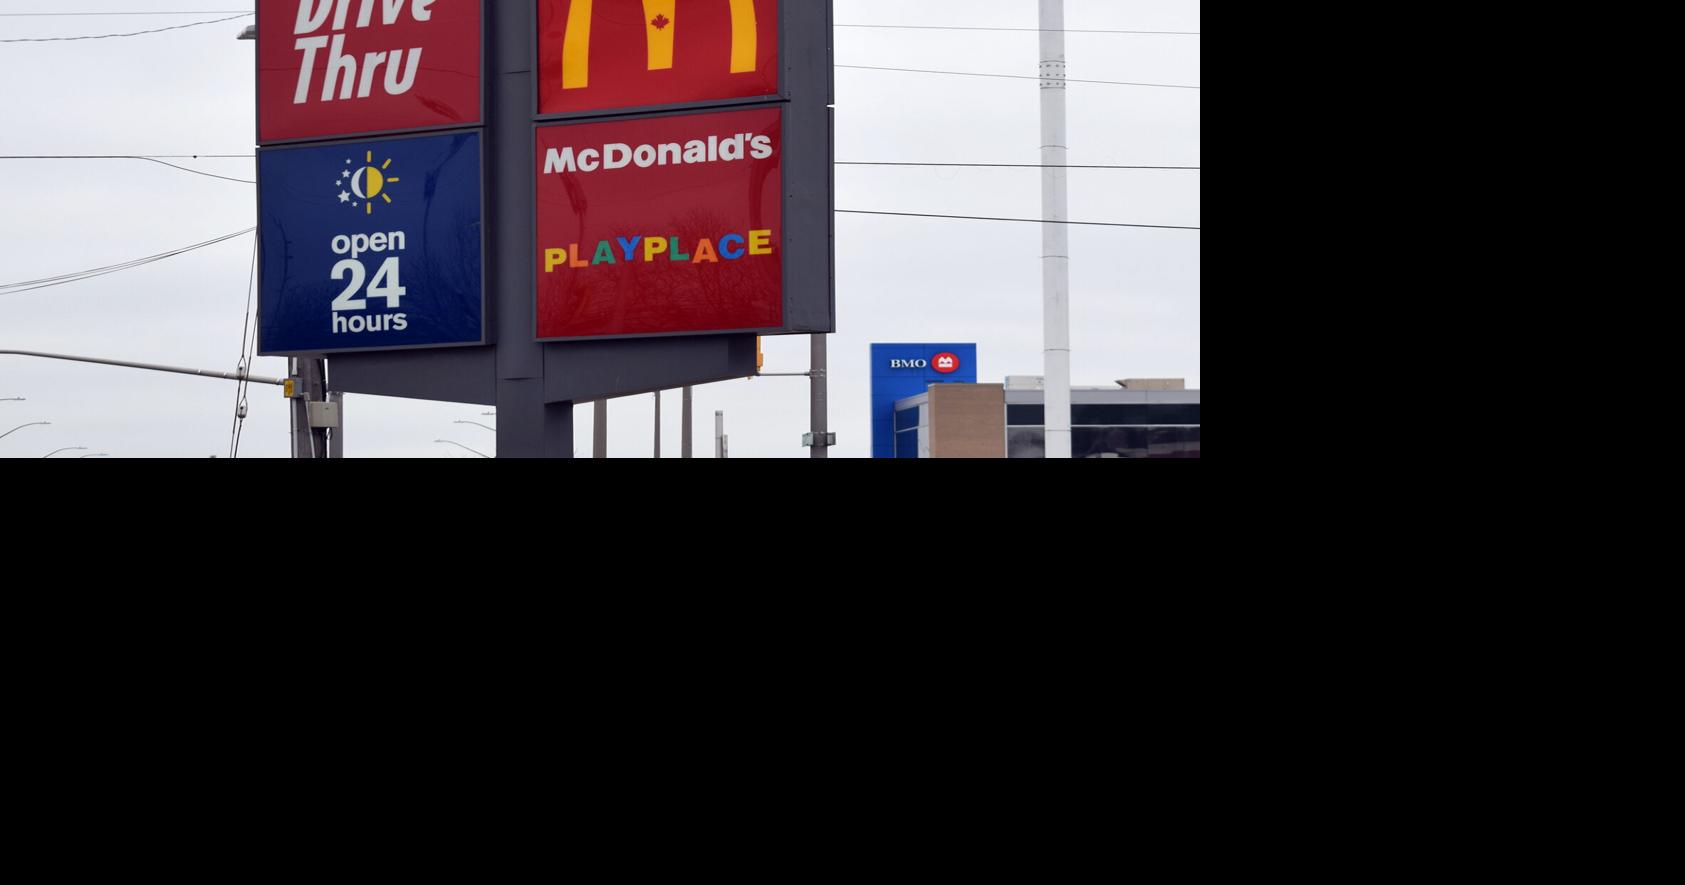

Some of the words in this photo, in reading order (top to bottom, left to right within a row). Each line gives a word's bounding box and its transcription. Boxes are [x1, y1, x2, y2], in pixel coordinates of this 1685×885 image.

[293, 33, 423, 104] Thru
[543, 132, 773, 174] McDonald's
[330, 230, 406, 259] open
[544, 229, 772, 273] PLAYPLACE
[330, 256, 406, 311] 24
[332, 311, 408, 333] hours
[890, 358, 927, 369] BMO
